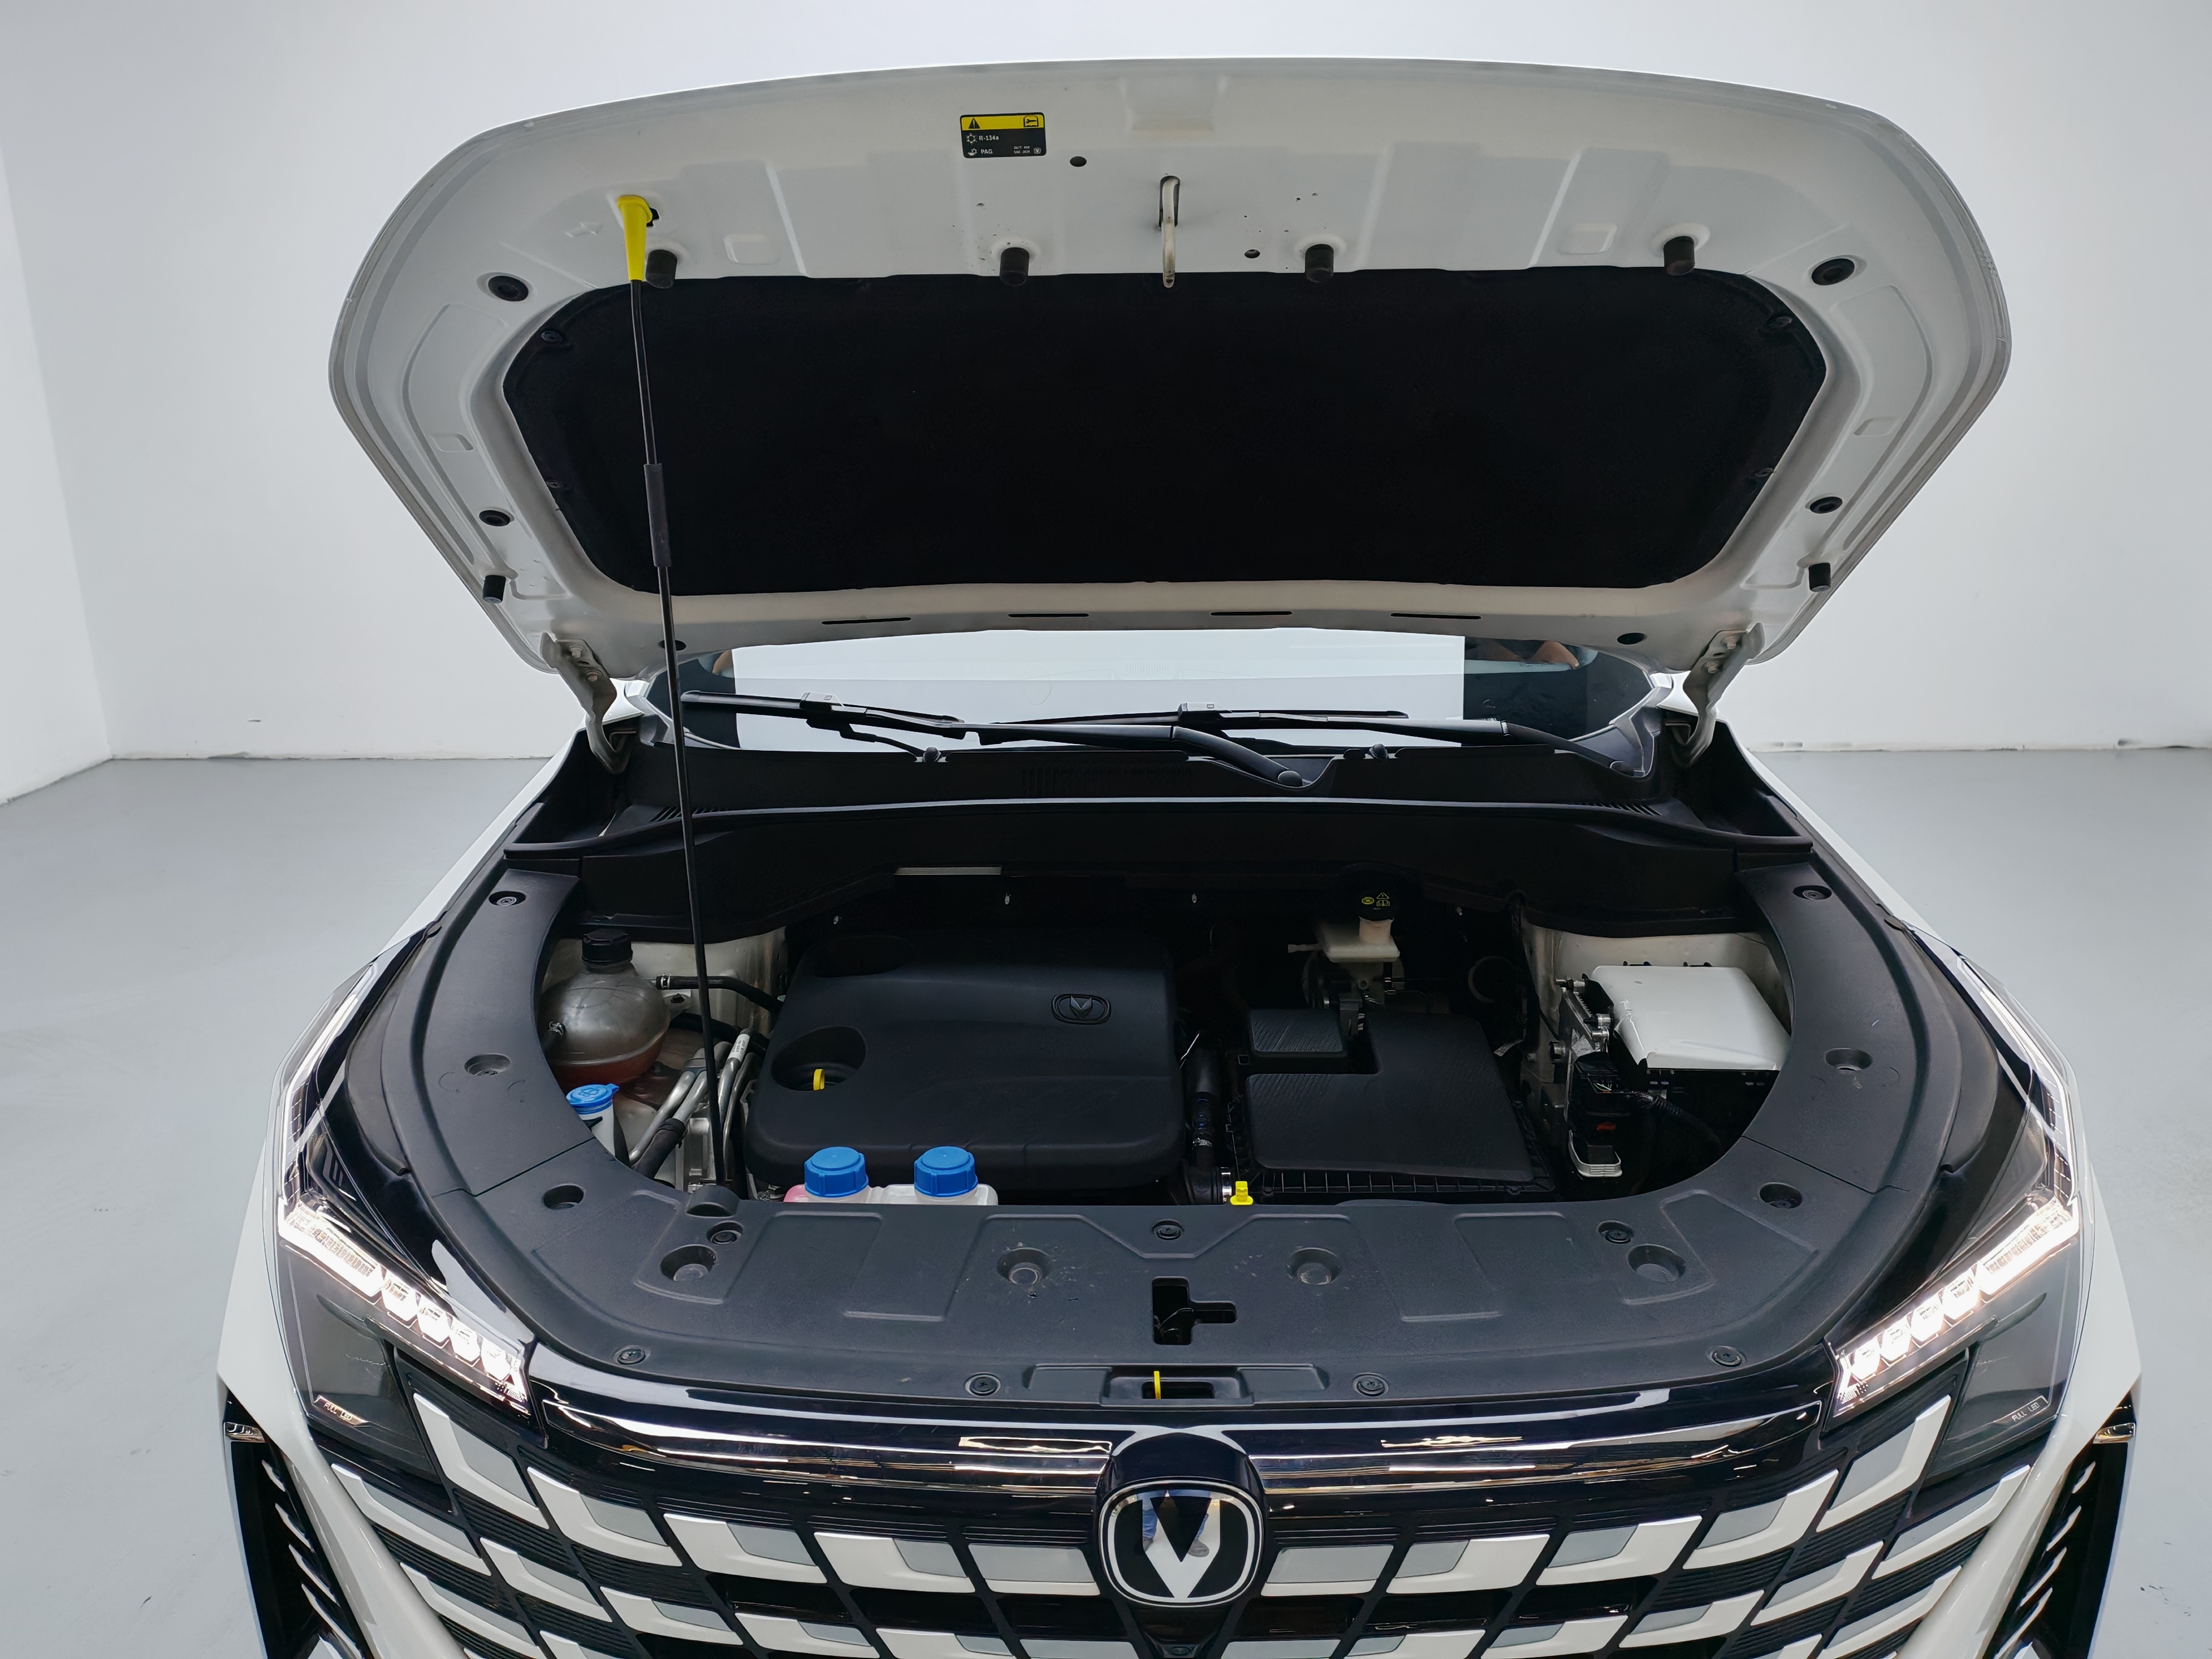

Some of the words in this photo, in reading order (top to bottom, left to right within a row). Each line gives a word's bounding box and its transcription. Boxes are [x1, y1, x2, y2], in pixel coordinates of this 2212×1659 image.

[323, 1402, 337, 1414] FULL
[340, 1411, 353, 1421] LED
[2012, 1411, 2027, 1422] FULL
[2027, 1402, 2040, 1412] LED
